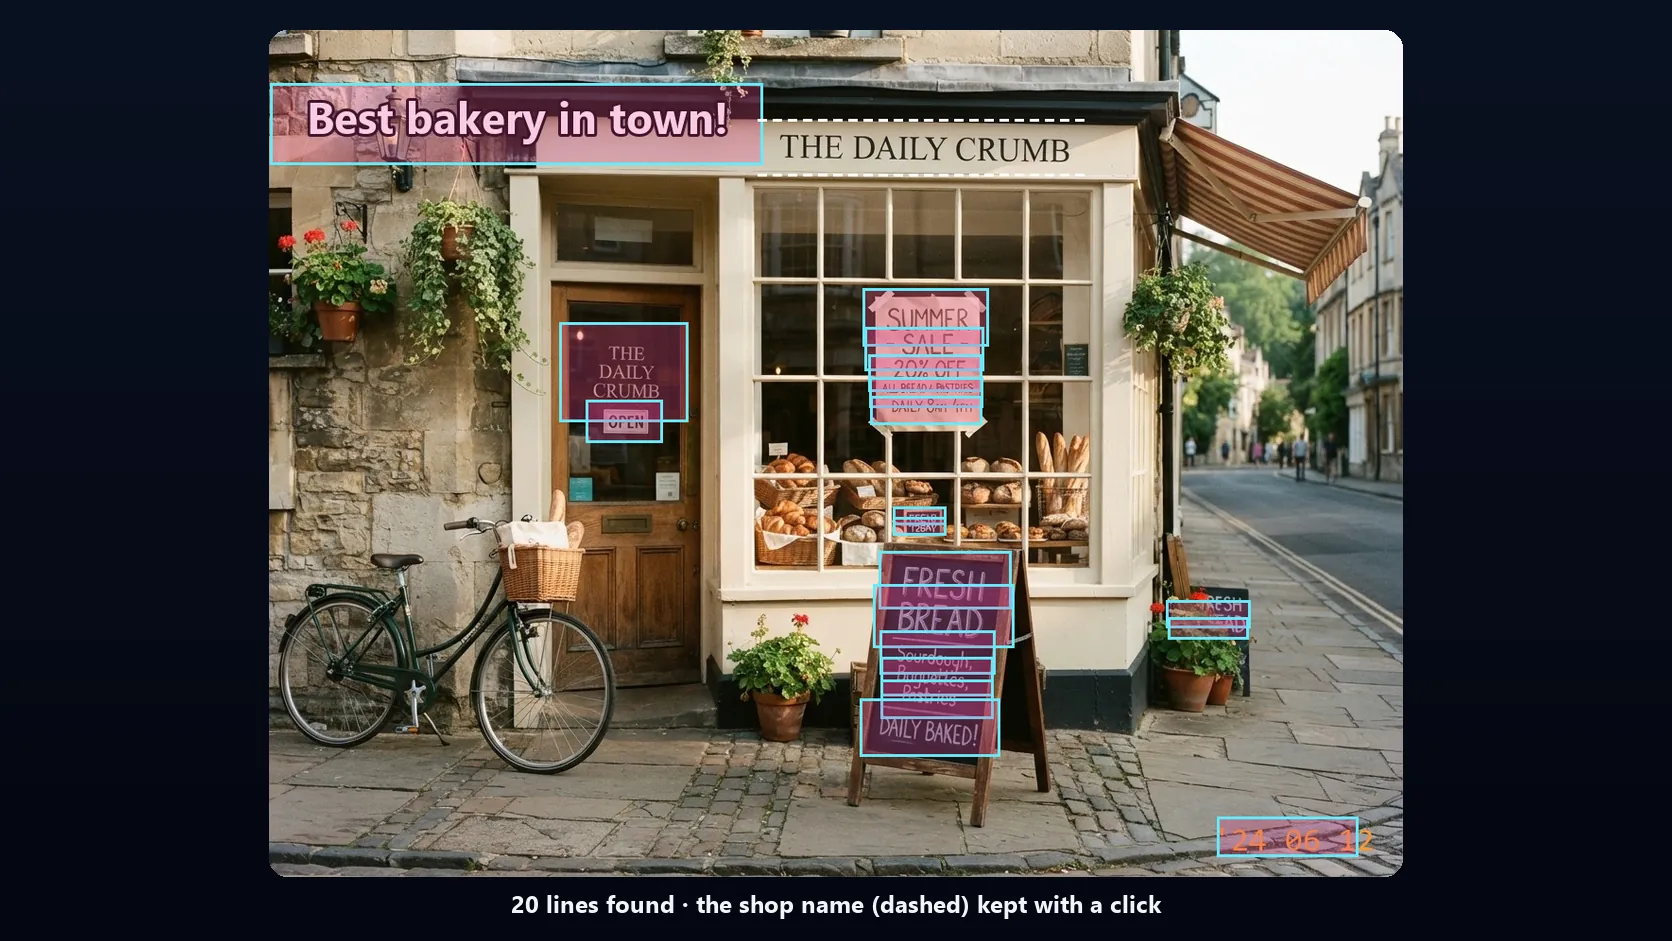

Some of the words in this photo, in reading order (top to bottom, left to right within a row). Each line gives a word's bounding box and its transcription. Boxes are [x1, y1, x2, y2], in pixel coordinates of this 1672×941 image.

[780, 134, 843, 159] THE
[853, 135, 948, 161] DAILY
[955, 137, 1070, 162] CRUMB
[887, 307, 970, 331] SUMMER
[608, 346, 645, 361] THE
[902, 333, 954, 355] SALE
[599, 364, 655, 380] DAILY
[894, 359, 929, 378] 20%
[935, 360, 966, 378] OFF
[593, 383, 660, 399] CRUMB
[892, 400, 923, 413] DAILY
[609, 415, 644, 429] OPEN
[902, 566, 986, 602] FRESH
[1206, 594, 1242, 612] RESH
[898, 601, 983, 639] BREAD
[880, 718, 921, 739] DAILY
[925, 720, 979, 747] BAKED!
